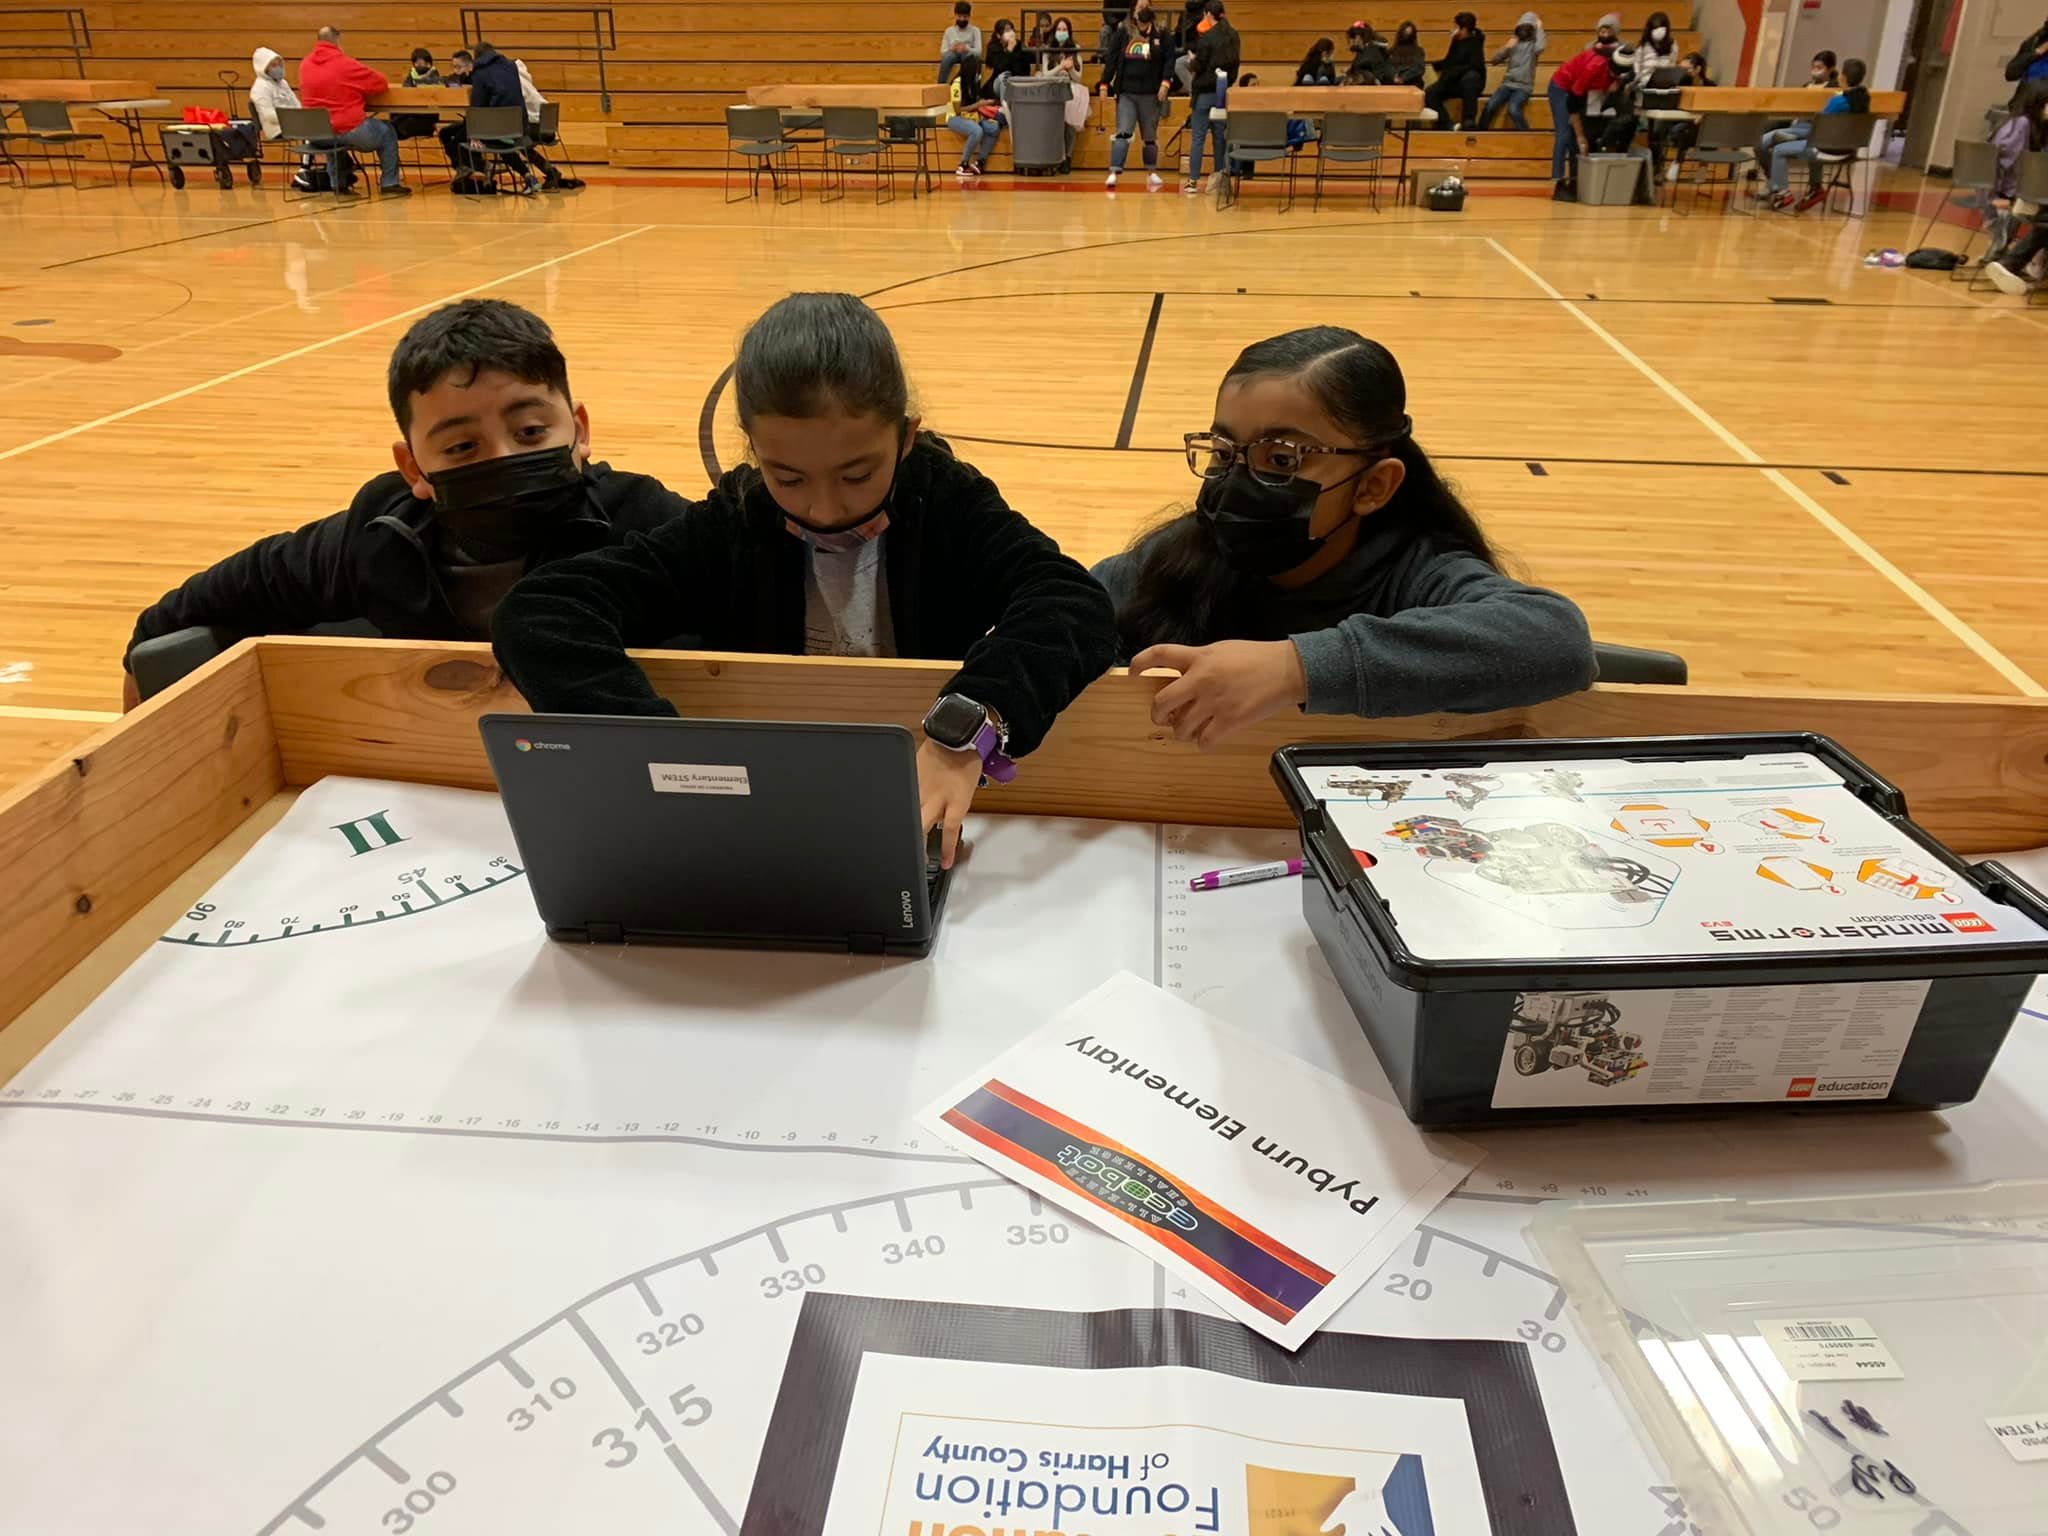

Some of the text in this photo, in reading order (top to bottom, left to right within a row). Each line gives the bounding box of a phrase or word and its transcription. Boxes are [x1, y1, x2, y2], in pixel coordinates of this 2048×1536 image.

[533, 740, 571, 751] chrome
[661, 773, 748, 785] Elementary STEM
[488, 856, 509, 869] 30
[397, 866, 428, 885] 45
[443, 873, 464, 885] 40
[391, 892, 412, 902] 50
[186, 901, 217, 922] 90
[338, 904, 360, 914] 60
[901, 890, 915, 929] Lenovo
[1849, 912, 1936, 924] education
[224, 919, 247, 930] 80
[280, 915, 301, 926] 70
[1700, 919, 1734, 928] EV3
[1953, 916, 1988, 929] LEGO
[1817, 1081, 1888, 1092] education
[74, 1089, 99, 1099] -27
[111, 1091, 137, 1102] -26
[149, 1094, 175, 1105] -25
[187, 1097, 213, 1108] -24
[226, 1100, 251, 1112] -23
[264, 1104, 290, 1115] -22
[303, 1106, 327, 1117] -21
[343, 1109, 367, 1120] -20
[380, 1112, 405, 1122] -19
[419, 1114, 443, 1124] -18
[458, 1116, 483, 1126] -17
[497, 1118, 521, 1128] -16
[537, 1120, 561, 1130] -15
[576, 1122, 600, 1132] -14
[615, 1122, 640, 1132] -13
[655, 1122, 680, 1132] -12
[695, 1124, 719, 1135] -11
[736, 1130, 761, 1140] -10
[780, 1131, 797, 1141] -9
[821, 1131, 838, 1141] -8
[861, 1134, 879, 1145] -7
[903, 1139, 919, 1149] -6
[1065, 1035, 1380, 1216] Pyburn Elementary
[1090, 1146, 1189, 1207] CHALLENGE
[1496, 1180, 1515, 1190] +8
[1540, 1183, 1559, 1193] +9
[1580, 1186, 1608, 1197] +10
[1005, 1224, 1070, 1246] 350
[880, 1234, 947, 1266] 340
[759, 1263, 828, 1300] 330
[1383, 1272, 1434, 1303] 20
[1171, 1287, 1188, 1300] -4
[634, 1312, 706, 1357] 320
[1516, 1318, 1568, 1355] 30
[506, 1376, 579, 1433] 310
[591, 1384, 715, 1470] 315
[1993, 1424, 2035, 1436] STEM
[922, 1435, 1169, 1481] of Harris County
[381, 1469, 459, 1536] 300
[915, 1472, 1220, 1532] Foundation
[1781, 1486, 1842, 1531] 50
